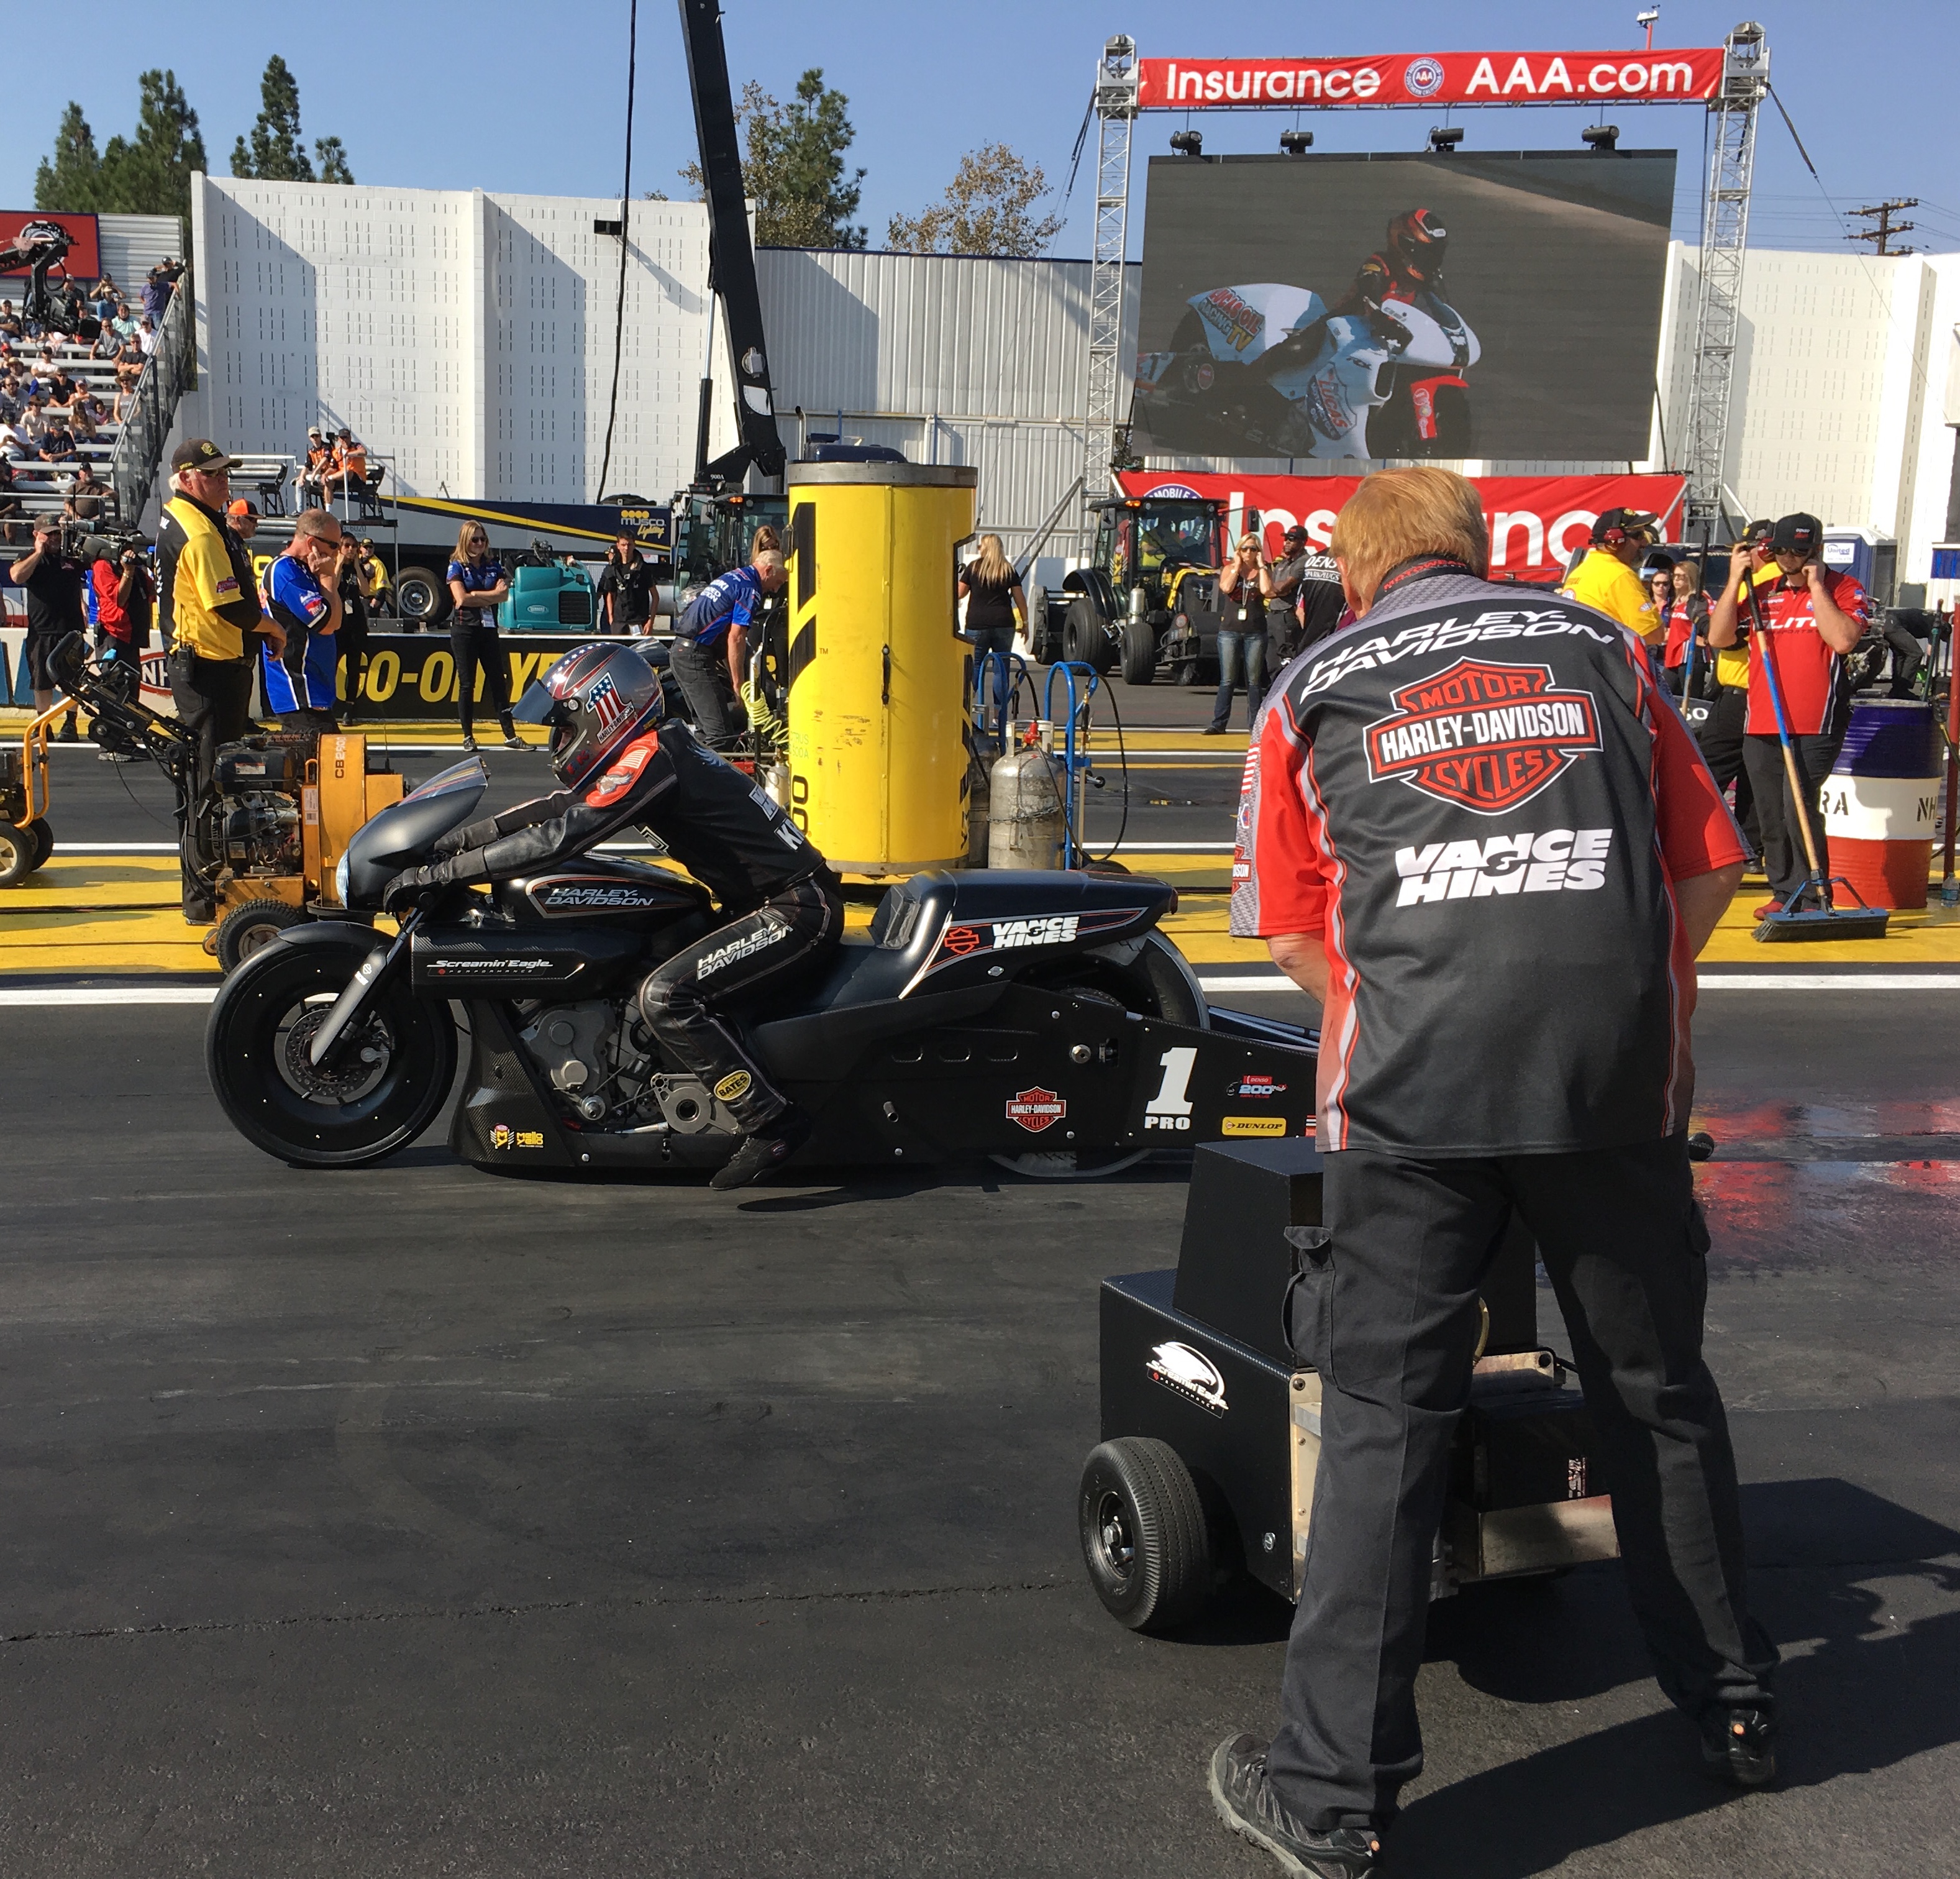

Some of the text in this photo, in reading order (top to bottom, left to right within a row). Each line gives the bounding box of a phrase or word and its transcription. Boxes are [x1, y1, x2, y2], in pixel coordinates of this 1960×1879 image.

[1167, 63, 1380, 100] Insurance
[1416, 71, 1433, 81] AAA
[1465, 57, 1693, 94] AAA.com
[1239, 306, 1265, 336] OIL
[1226, 325, 1254, 352] TV
[1317, 380, 1349, 428] LUCAS
[1305, 556, 1338, 569] DENS
[1827, 547, 1850, 555] United
[1308, 610, 1567, 683] HARLEY-
[1300, 621, 1615, 705] DAVIDSON
[1420, 670, 1531, 710] MOTOR
[599, 705, 634, 741] HARLEY-DAVIDSON
[1381, 702, 1585, 762] HARLEY-DAVIDSON
[1436, 749, 1544, 800] CYCLES
[1396, 828, 1613, 877] VANCE
[551, 888, 638, 897] HARLEY-
[1396, 860, 1607, 907] HINES
[545, 897, 654, 906] DAVIDSON
[992, 917, 1080, 936] VANCE
[993, 929, 1077, 949] HINES
[697, 925, 794, 981] DAVIDSON
[698, 921, 778, 969] HARLEY-
[508, 959, 553, 969] Eagle
[718, 1074, 748, 1097] BATES
[1145, 1047, 1198, 1115] 1
[1239, 1084, 1274, 1094] 200
[1011, 1104, 1062, 1114] HARLEY-DAVIDSON
[1023, 1092, 1051, 1102] MOTOR
[1022, 1116, 1050, 1128] CYCLES
[1144, 1116, 1191, 1130] PRO
[1197, 1384, 1229, 1410] Eagle
